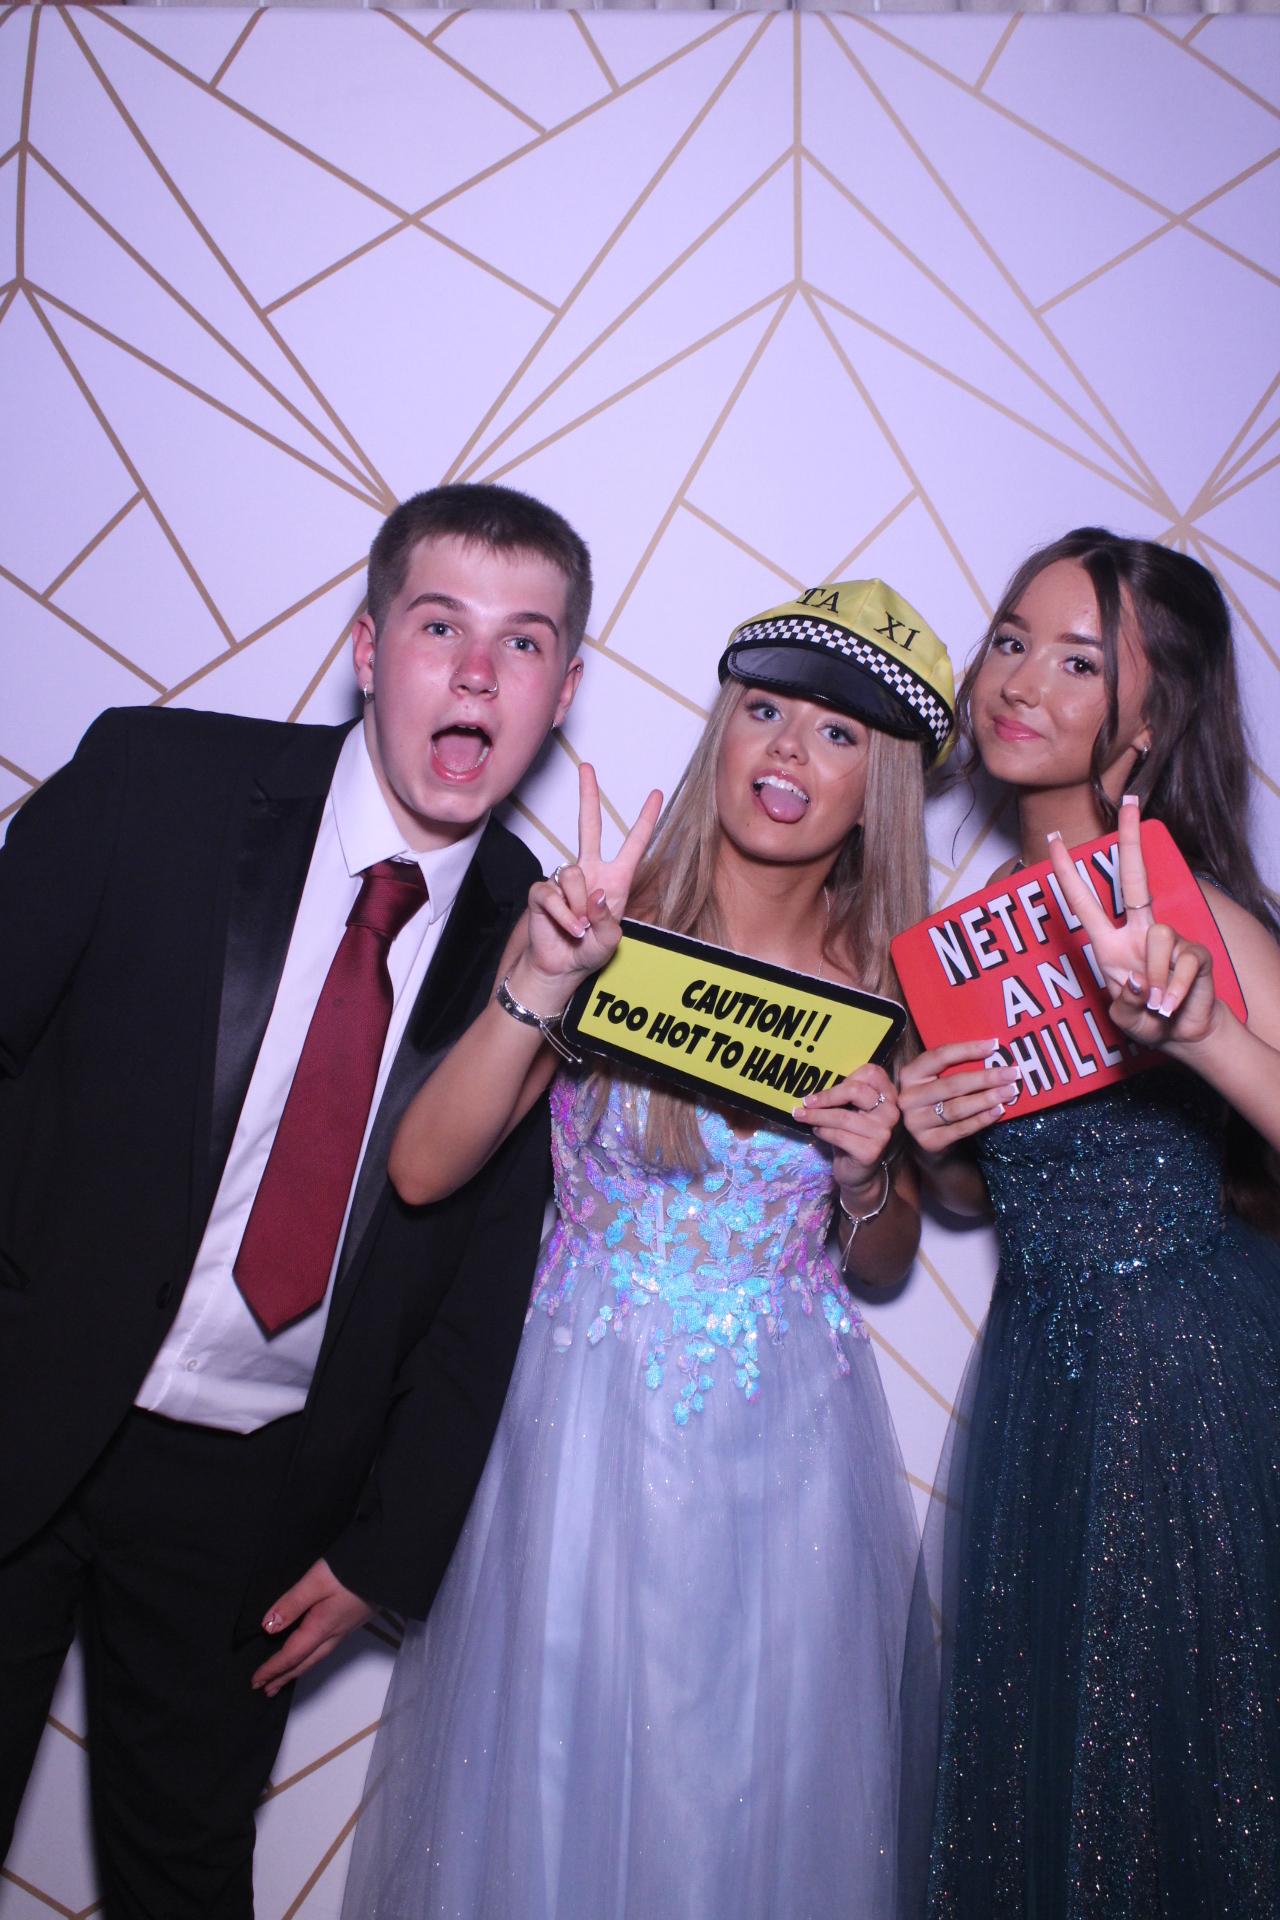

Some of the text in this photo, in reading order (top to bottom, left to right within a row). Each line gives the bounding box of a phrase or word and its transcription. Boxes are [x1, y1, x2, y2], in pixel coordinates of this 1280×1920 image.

[593, 991, 847, 1098] TOO HOT TO HANDL
[682, 980, 829, 1052] CAUTION!!
